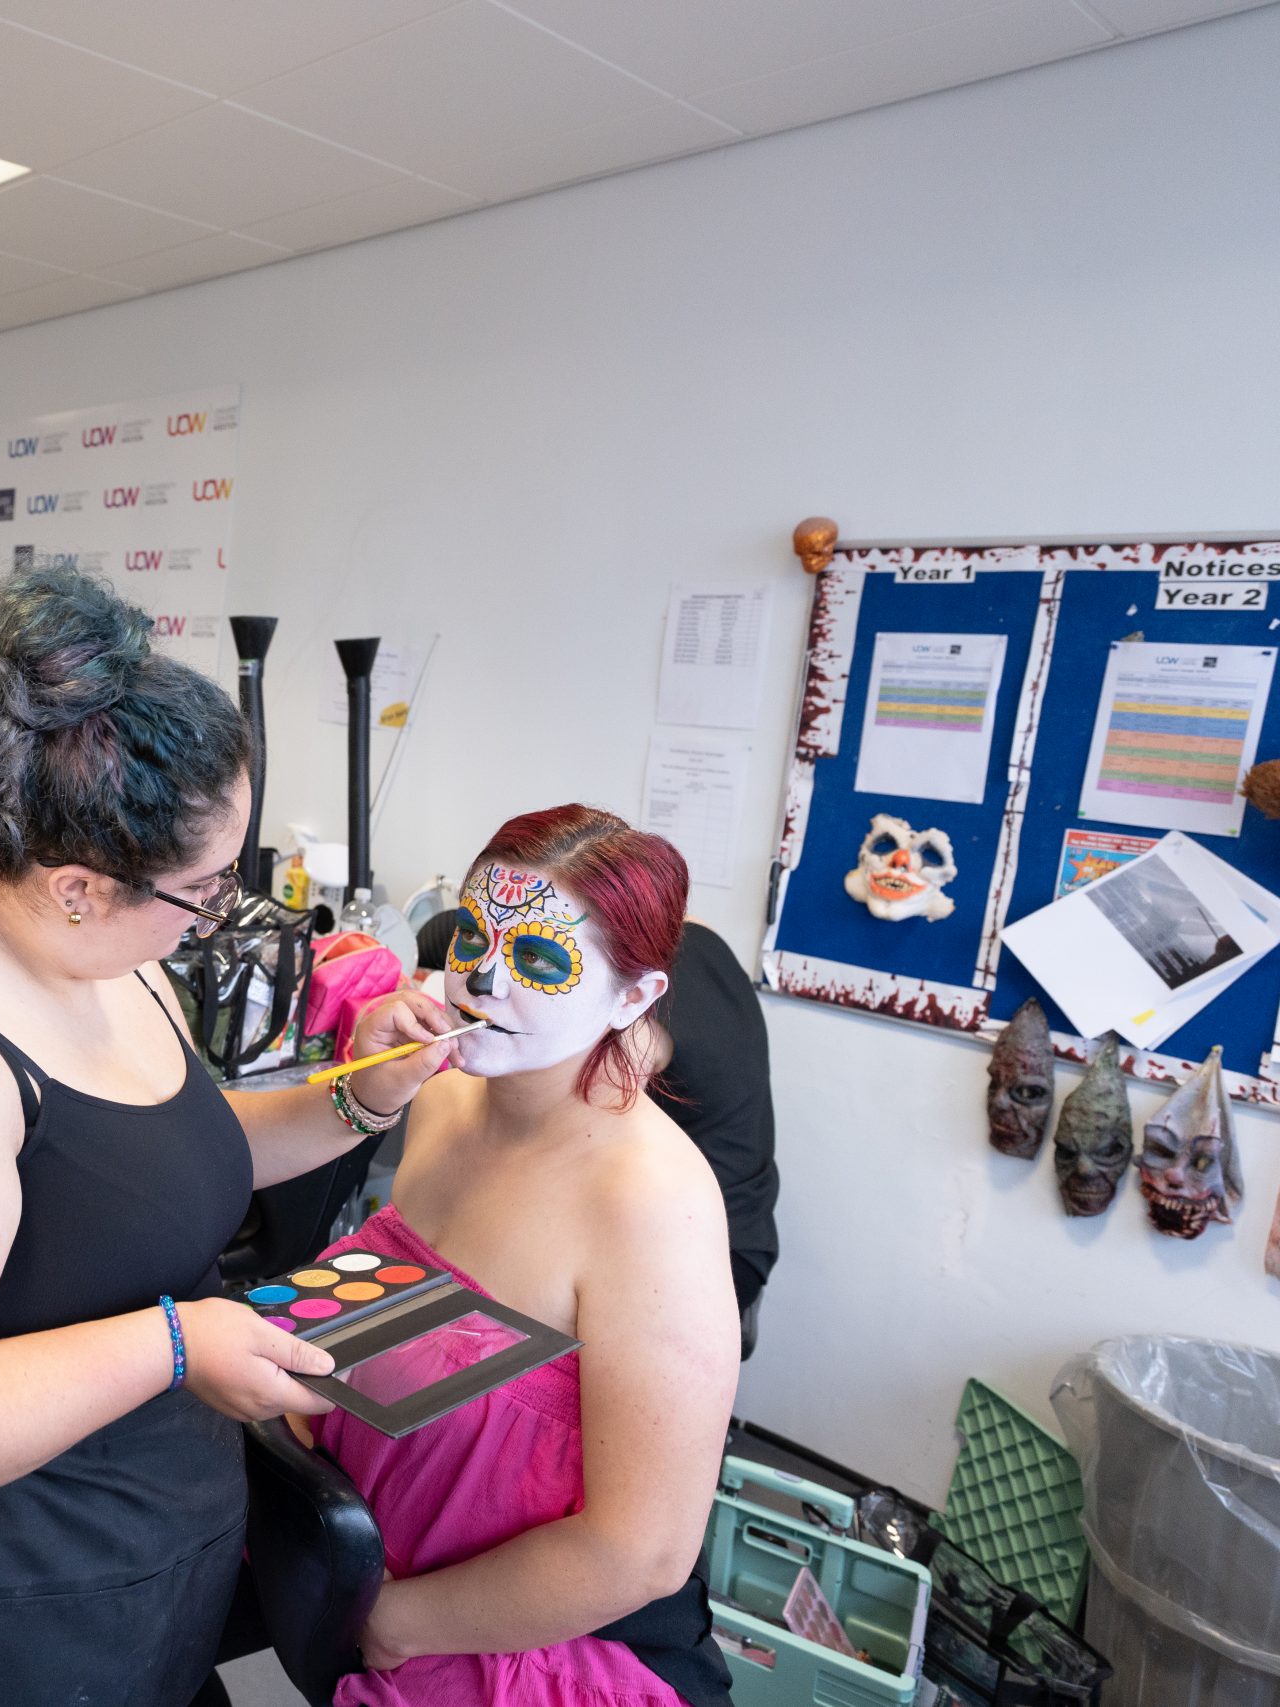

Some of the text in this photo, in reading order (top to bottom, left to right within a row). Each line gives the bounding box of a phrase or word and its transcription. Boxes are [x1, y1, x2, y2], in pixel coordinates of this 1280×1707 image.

[166, 412, 207, 436] UCW
[82, 425, 116, 448] UCW
[8, 437, 38, 458] UCW
[103, 486, 139, 508] UCW
[192, 479, 233, 501] UCW
[27, 495, 58, 514] UCW
[125, 551, 162, 571] UCW
[1164, 560, 1280, 577] Notices
[899, 565, 973, 580] Year 1
[1164, 589, 1261, 605] Year 2
